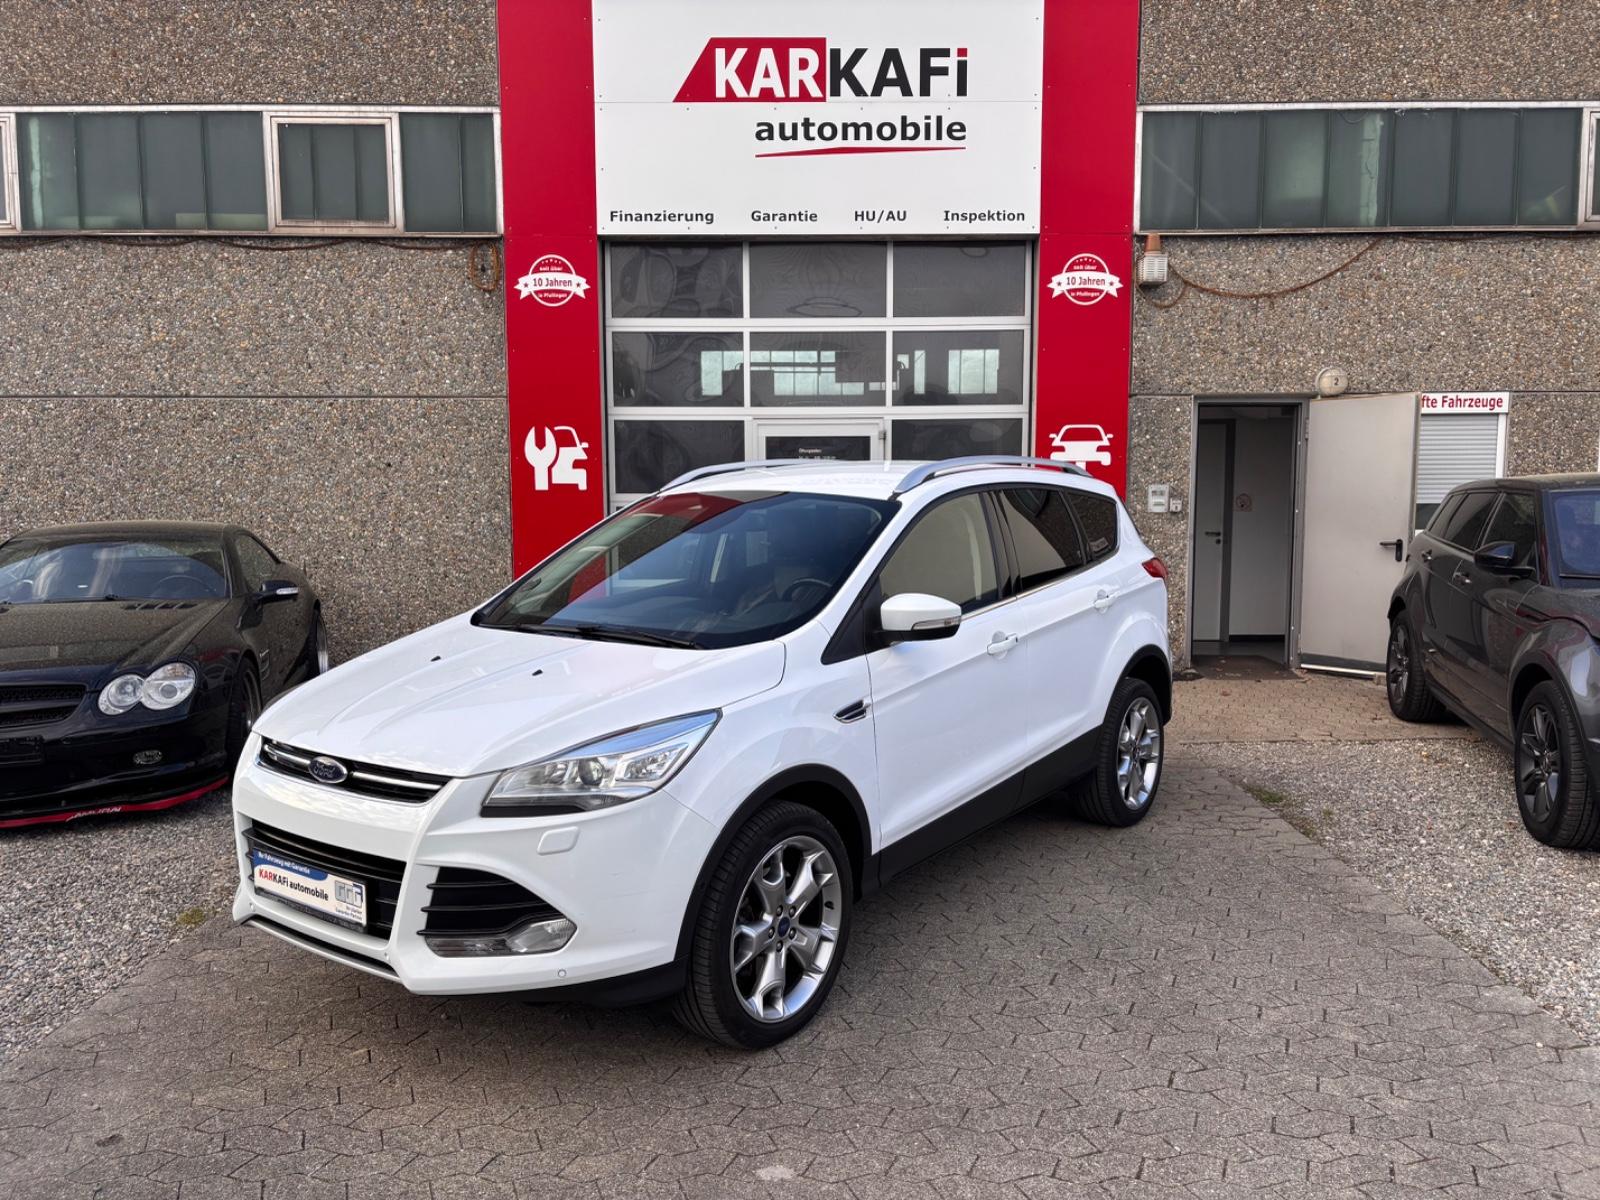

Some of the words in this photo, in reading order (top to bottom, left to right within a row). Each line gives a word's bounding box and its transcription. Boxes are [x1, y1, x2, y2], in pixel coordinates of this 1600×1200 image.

[715, 47, 968, 98] KARKAFi
[755, 115, 967, 141] automobile
[609, 210, 715, 225] Finanzierung
[751, 210, 818, 223] Garantie
[854, 210, 907, 224] HU/AU
[943, 210, 1026, 225] Inspektion
[533, 277, 543, 287] 10
[545, 277, 573, 287] Jahren
[1066, 276, 1076, 286] 10
[1078, 276, 1106, 286] Jahren
[1441, 395, 1503, 410] Fahrzeuge
[259, 868, 289, 887] KARKAFi
[289, 880, 329, 901] automobile
